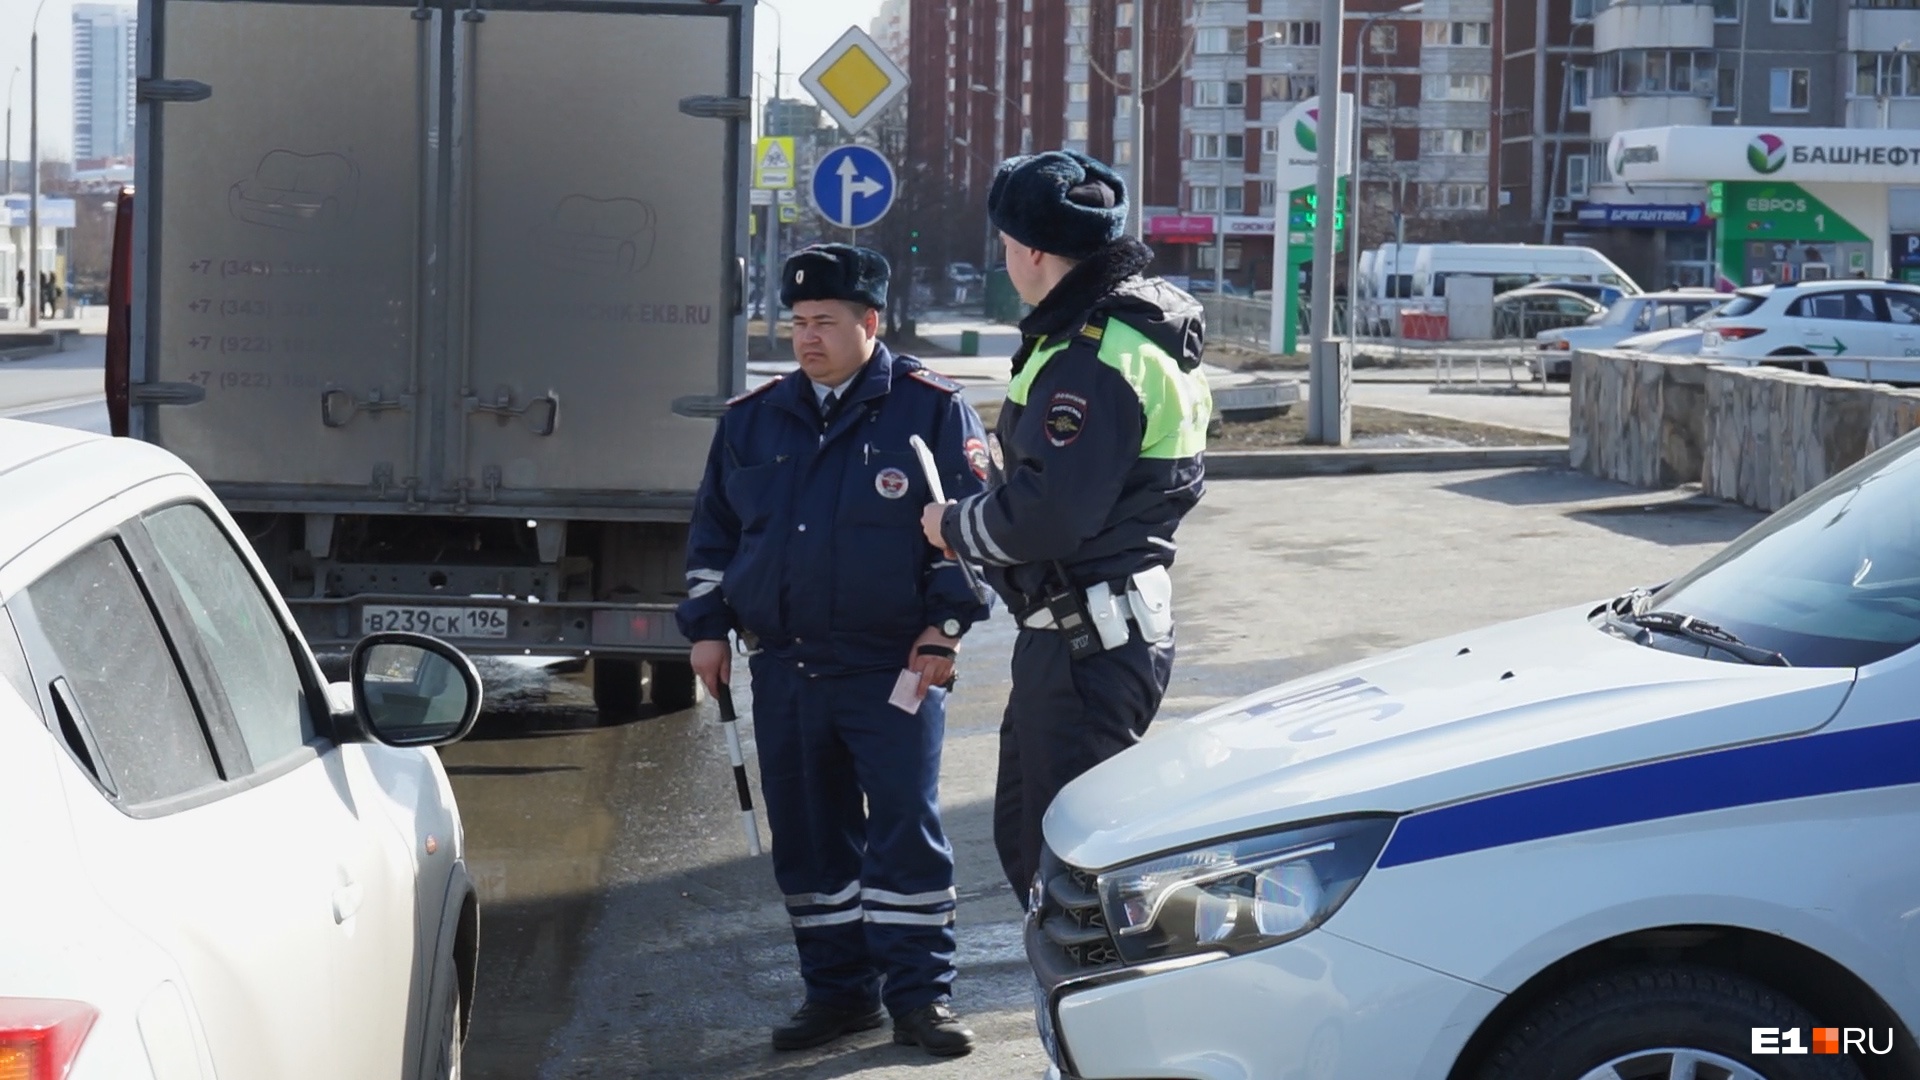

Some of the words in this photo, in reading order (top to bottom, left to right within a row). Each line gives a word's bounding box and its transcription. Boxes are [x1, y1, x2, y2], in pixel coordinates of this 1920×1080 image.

[1791, 145, 1920, 167] БАШНЕФТ
[1610, 209, 1688, 222] БРИГАНТИНА
[1814, 214, 1826, 232] 1
[188, 259, 213, 275] +7
[187, 298, 213, 315] +7
[219, 299, 272, 319] (343)
[187, 335, 213, 352] +7
[219, 335, 272, 355] (922)
[187, 370, 213, 386] +7
[219, 371, 272, 390] (922)
[370, 609, 460, 633] В239СК
[466, 610, 499, 628] 196
